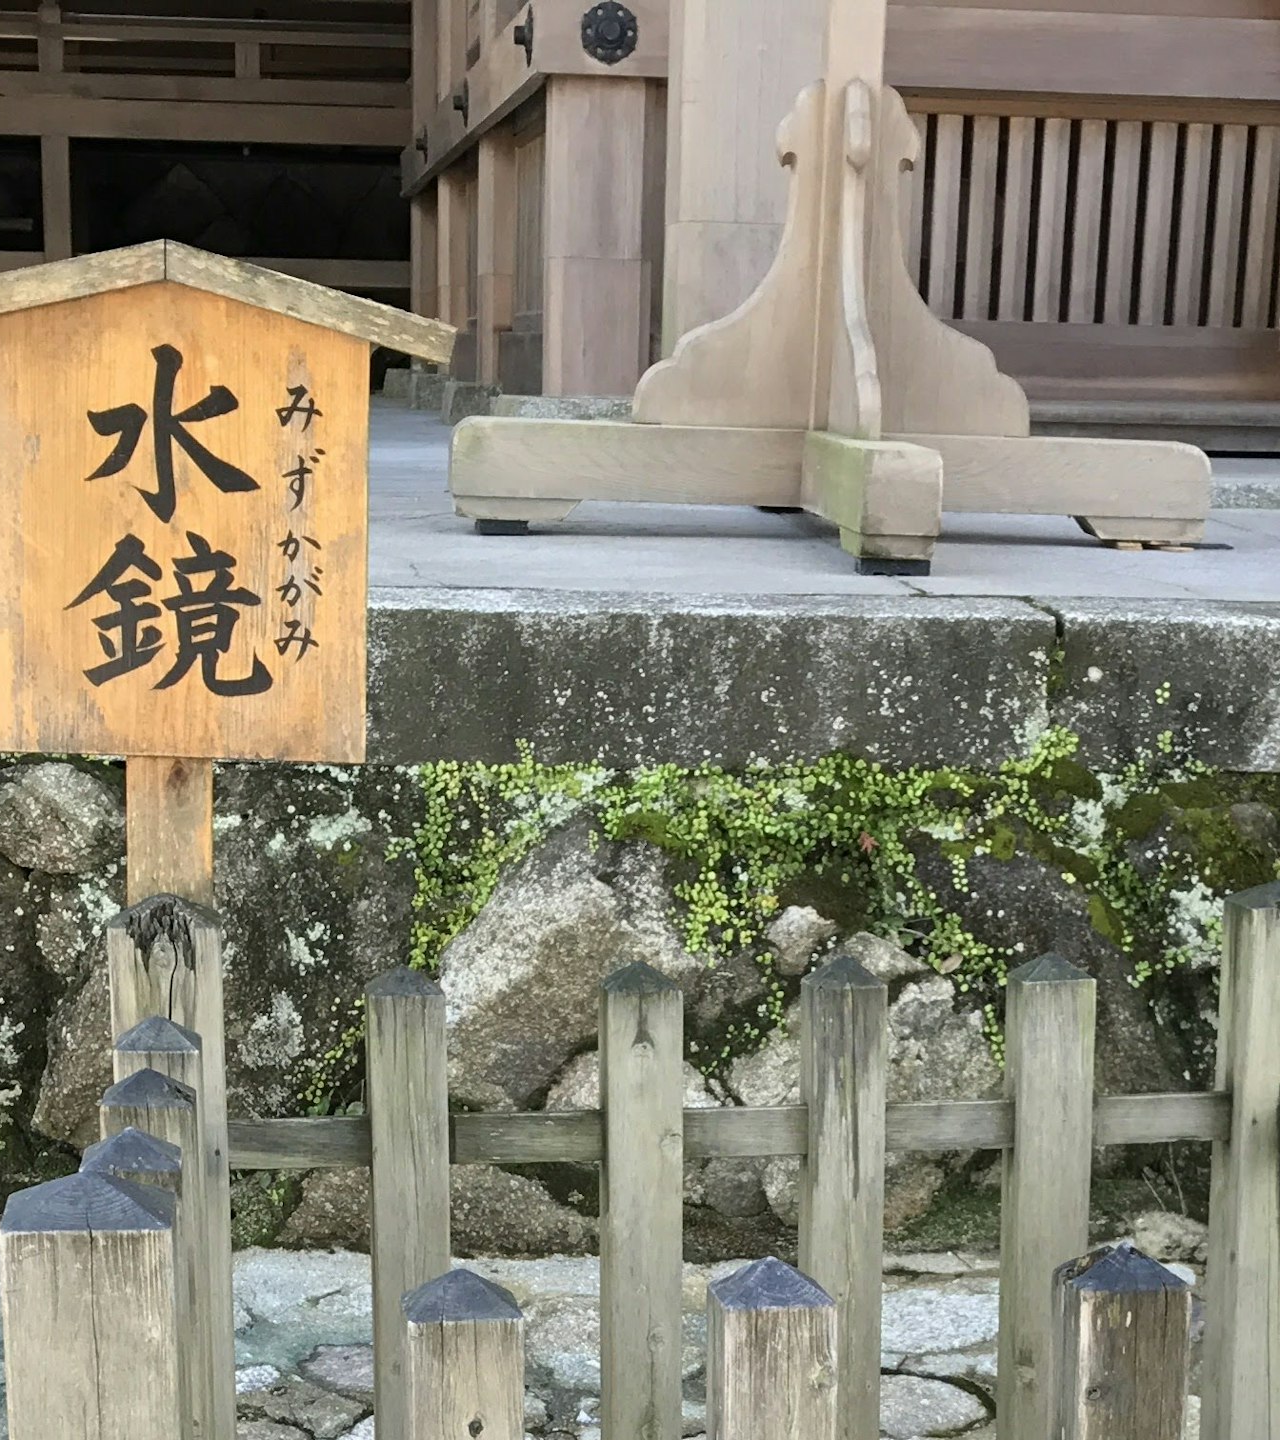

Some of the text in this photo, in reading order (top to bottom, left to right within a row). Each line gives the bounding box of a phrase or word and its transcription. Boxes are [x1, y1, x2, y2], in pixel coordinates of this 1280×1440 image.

[63, 343, 274, 697] 水鏡
[275, 383, 327, 663] みずかがみ
